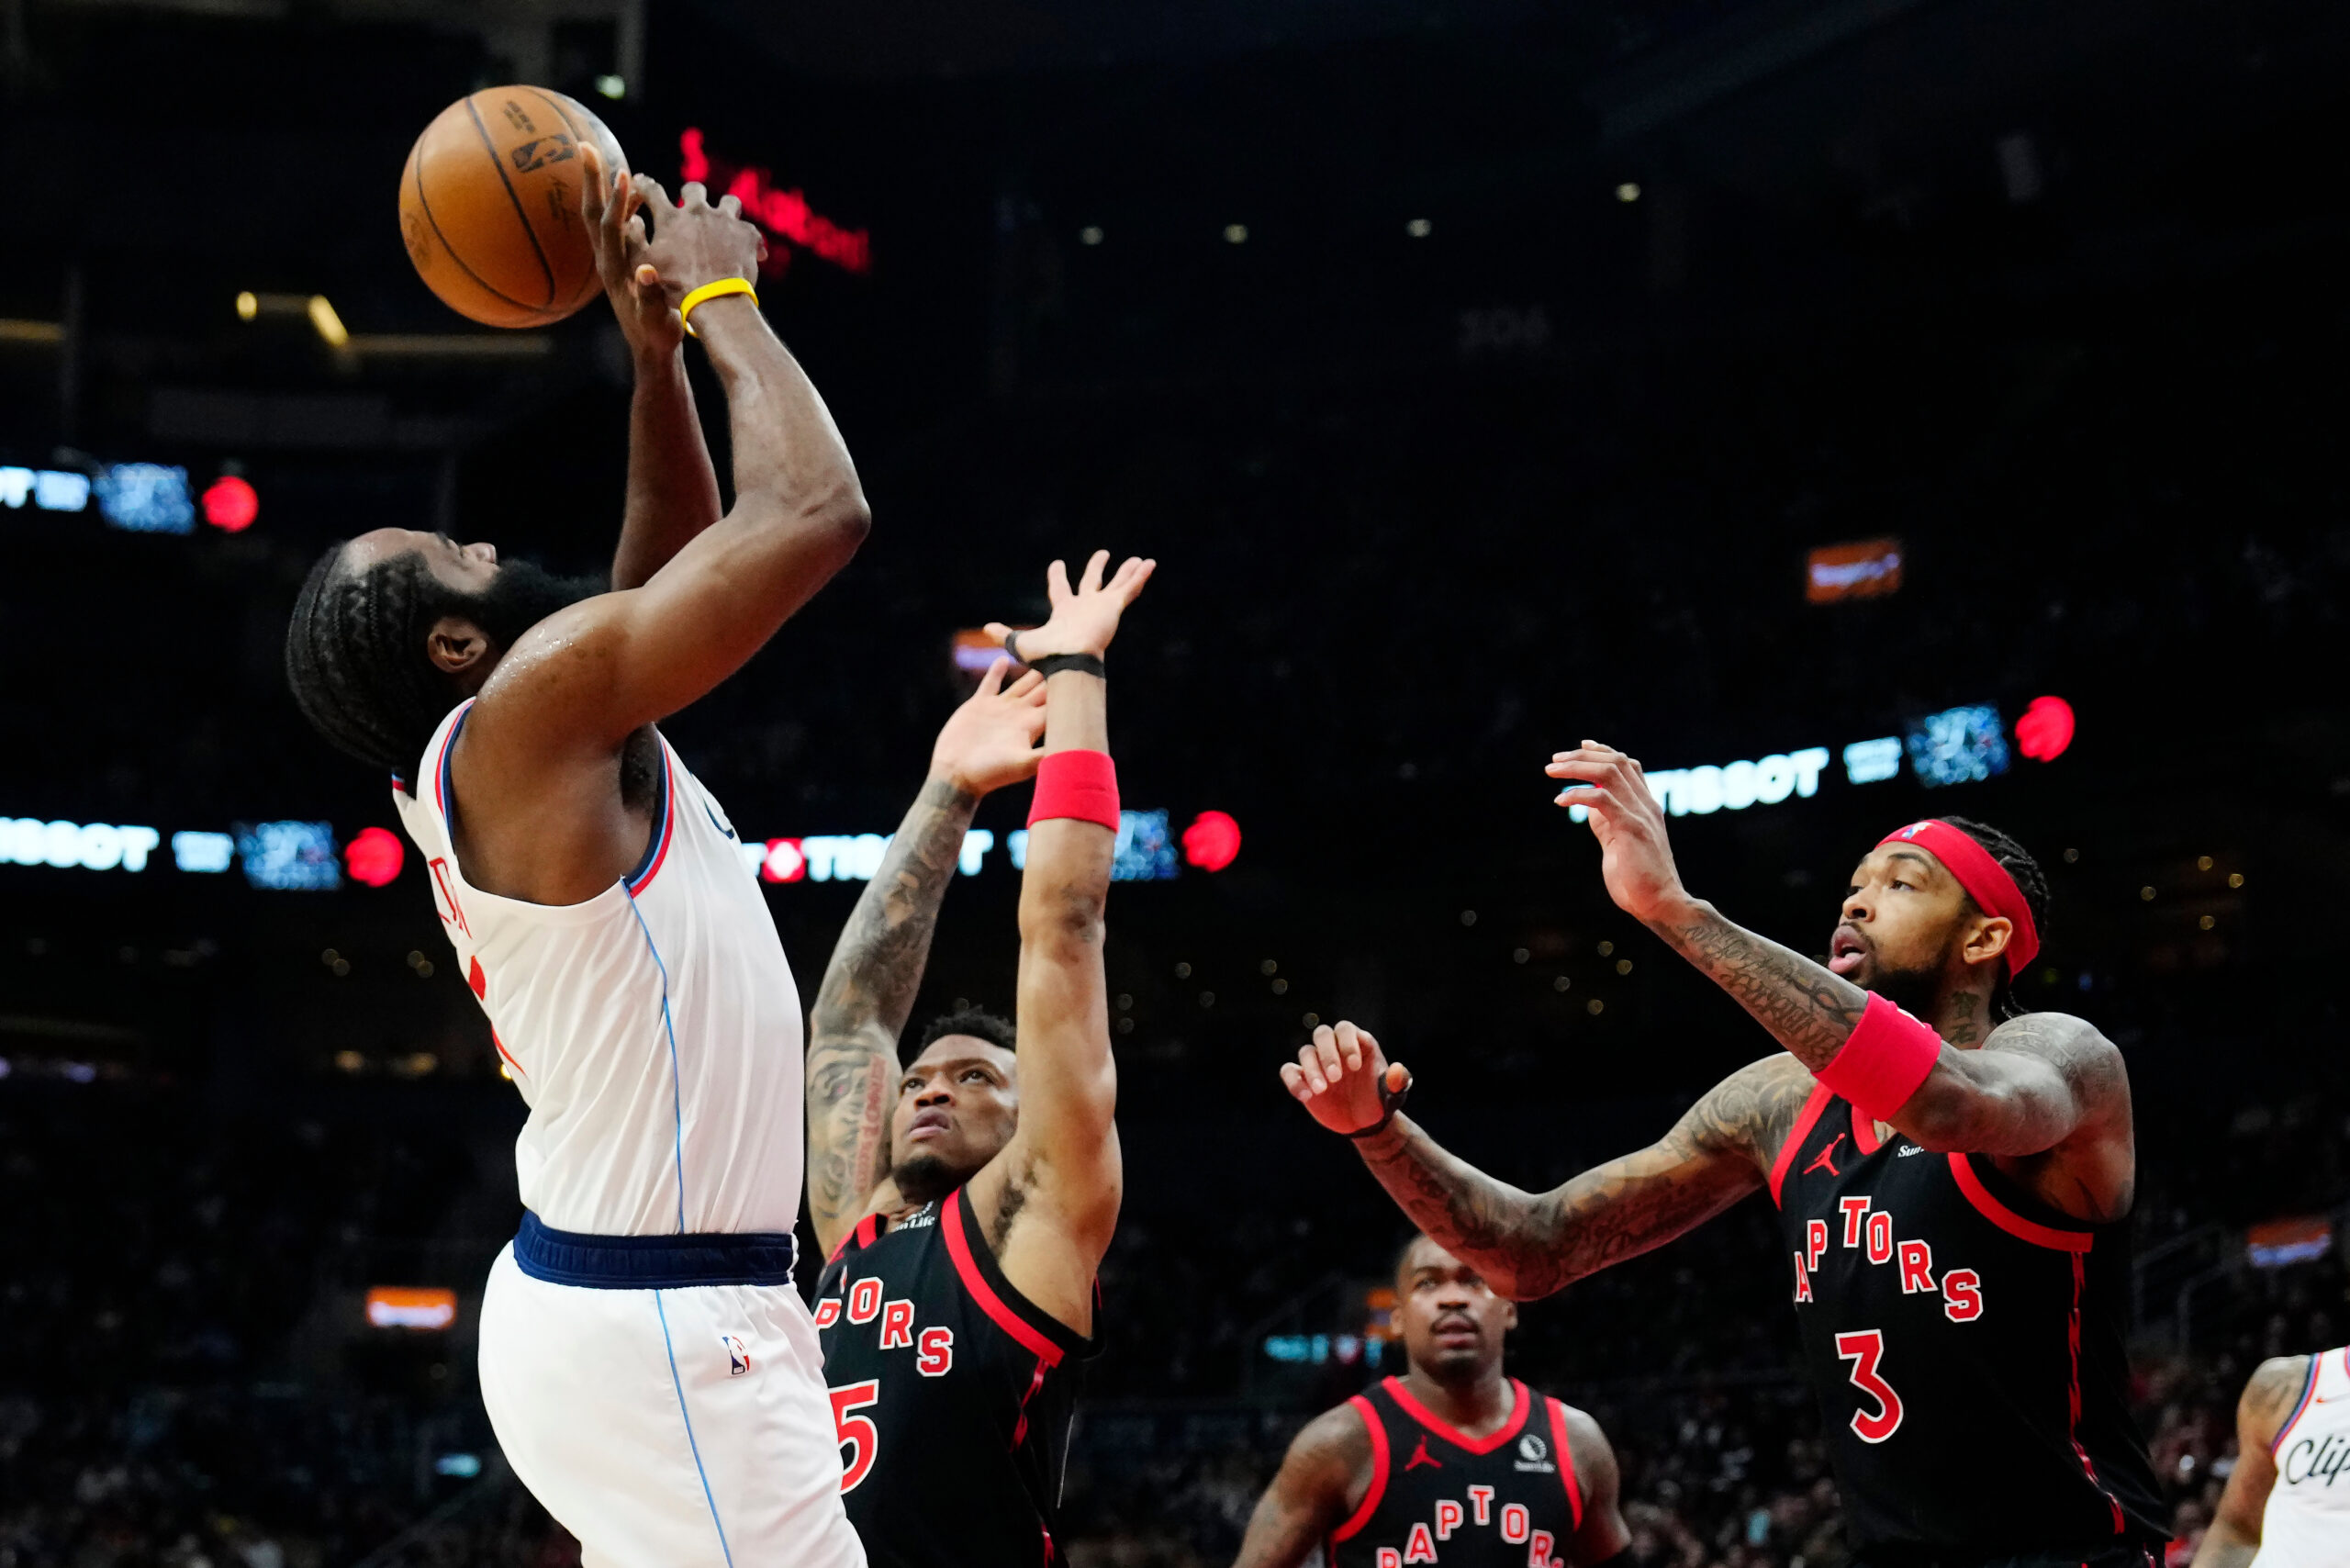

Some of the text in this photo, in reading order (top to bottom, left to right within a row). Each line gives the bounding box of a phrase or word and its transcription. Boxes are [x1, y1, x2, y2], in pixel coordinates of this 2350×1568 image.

[814, 1265, 954, 1377] PORS
[828, 1379, 879, 1495] 5
[1835, 1328, 1904, 1444] 3
[1375, 1484, 1564, 1568] RAPTOR
